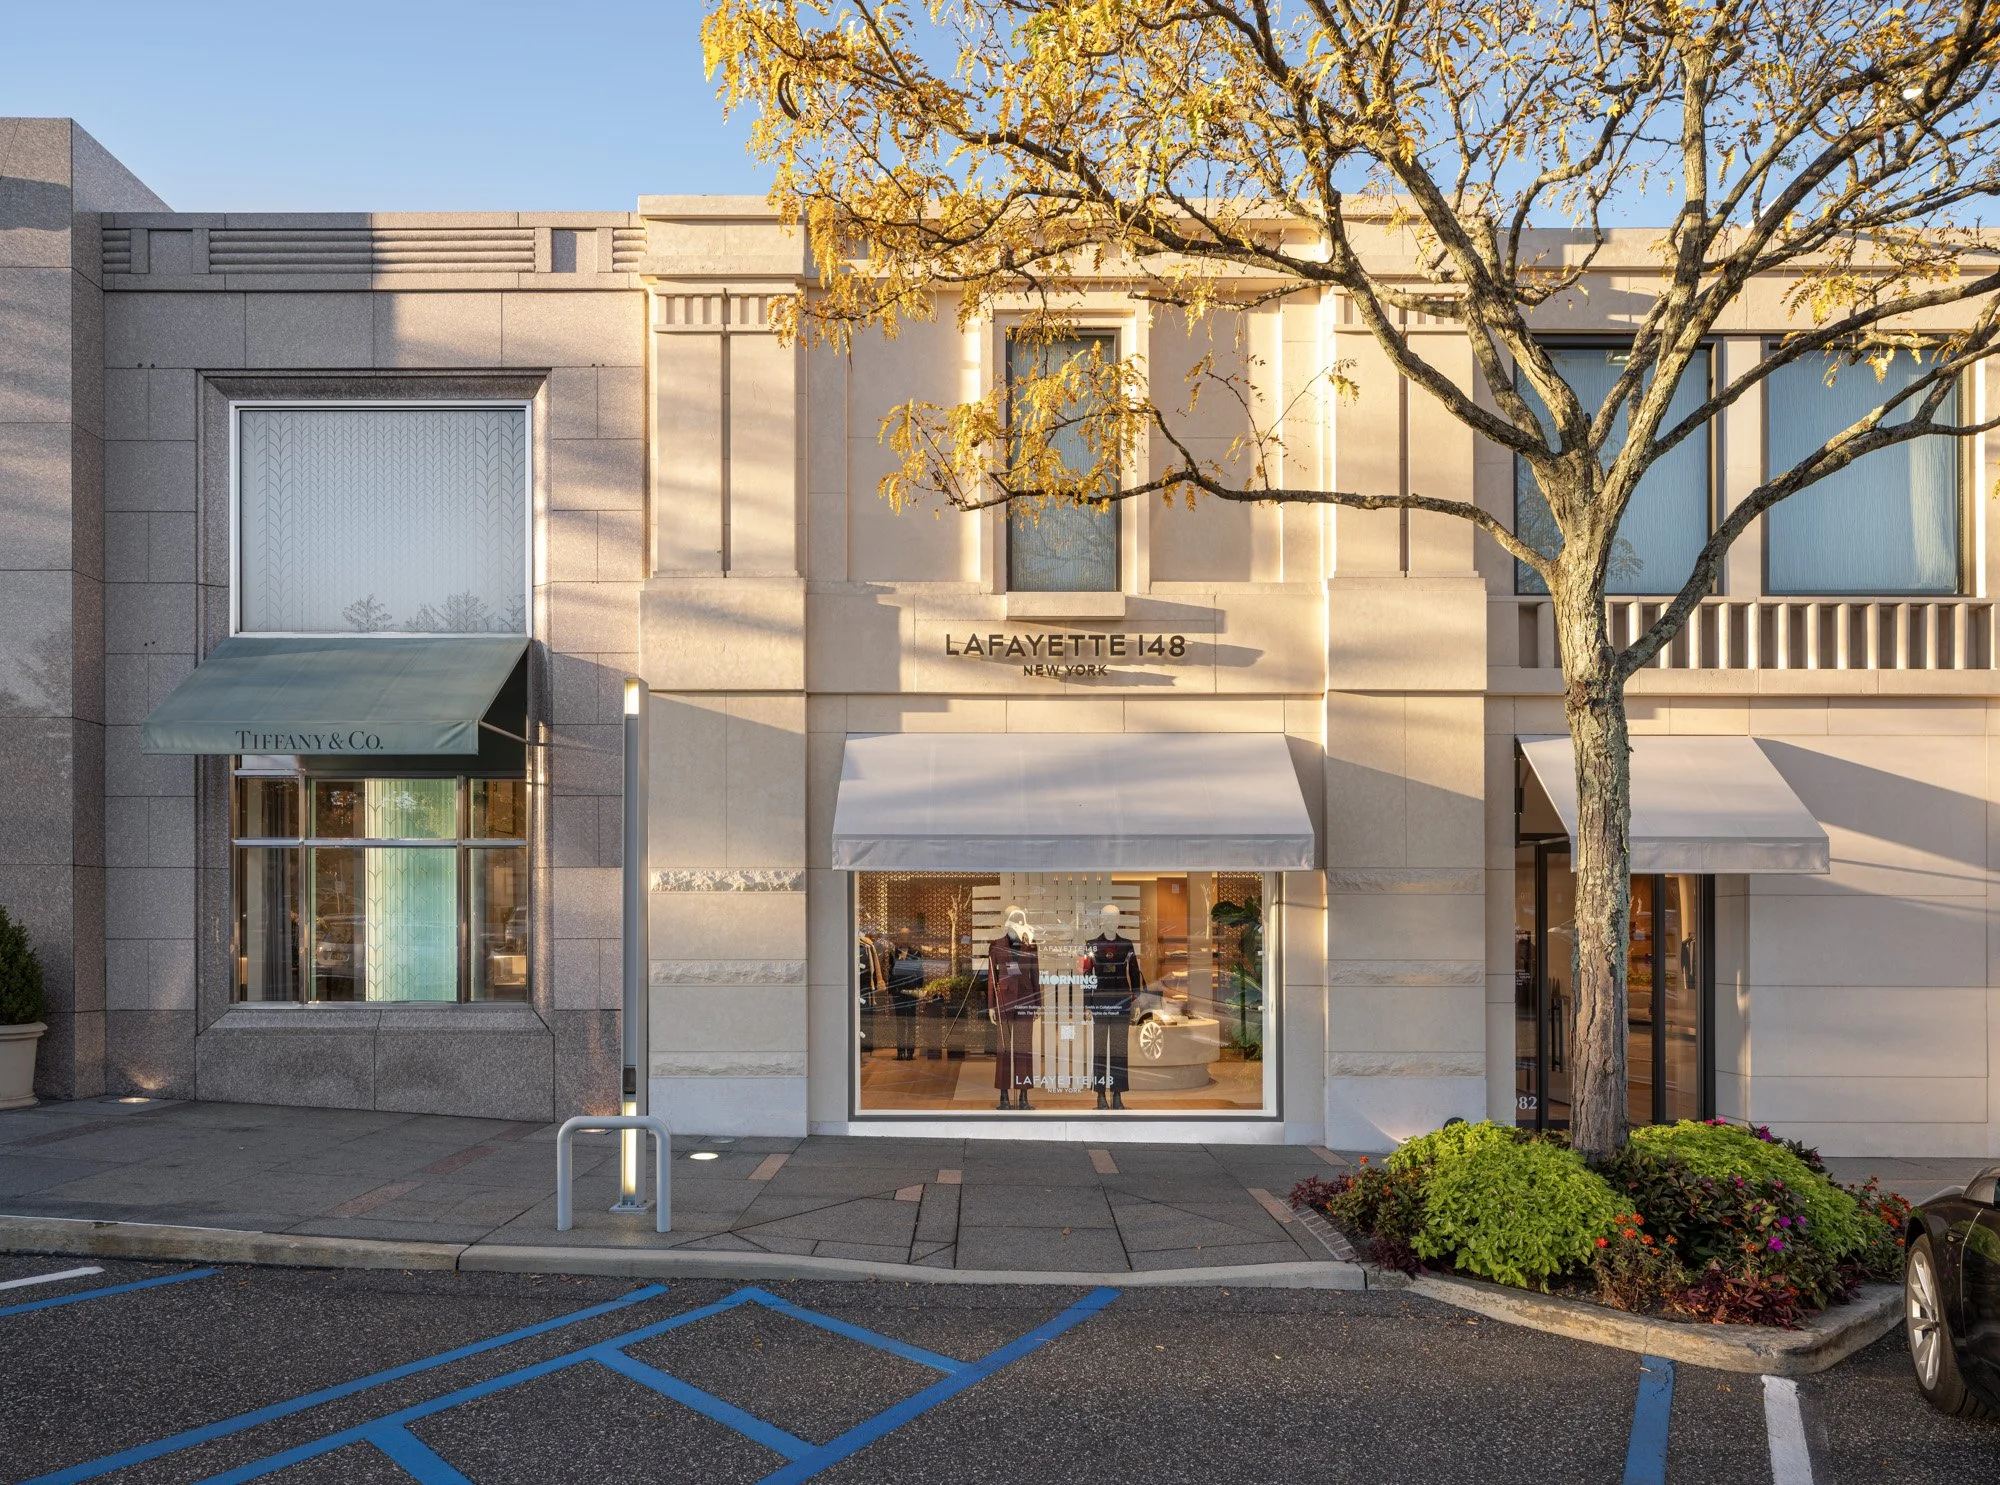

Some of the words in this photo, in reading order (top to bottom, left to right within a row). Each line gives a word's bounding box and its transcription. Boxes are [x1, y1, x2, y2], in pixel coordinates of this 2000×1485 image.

[946, 634, 1126, 657] LAFAYETTE
[1138, 634, 1186, 657] 148
[1023, 664, 1060, 677] NEW
[1065, 664, 1108, 676] YORK
[235, 730, 326, 750] TIFFANY
[328, 732, 344, 750] &
[1039, 975, 1098, 985] MORNING
[1015, 1075, 1088, 1085] LAFAYETTE
[1094, 1075, 1114, 1086] 148
[1516, 1096, 1538, 1110] 82
